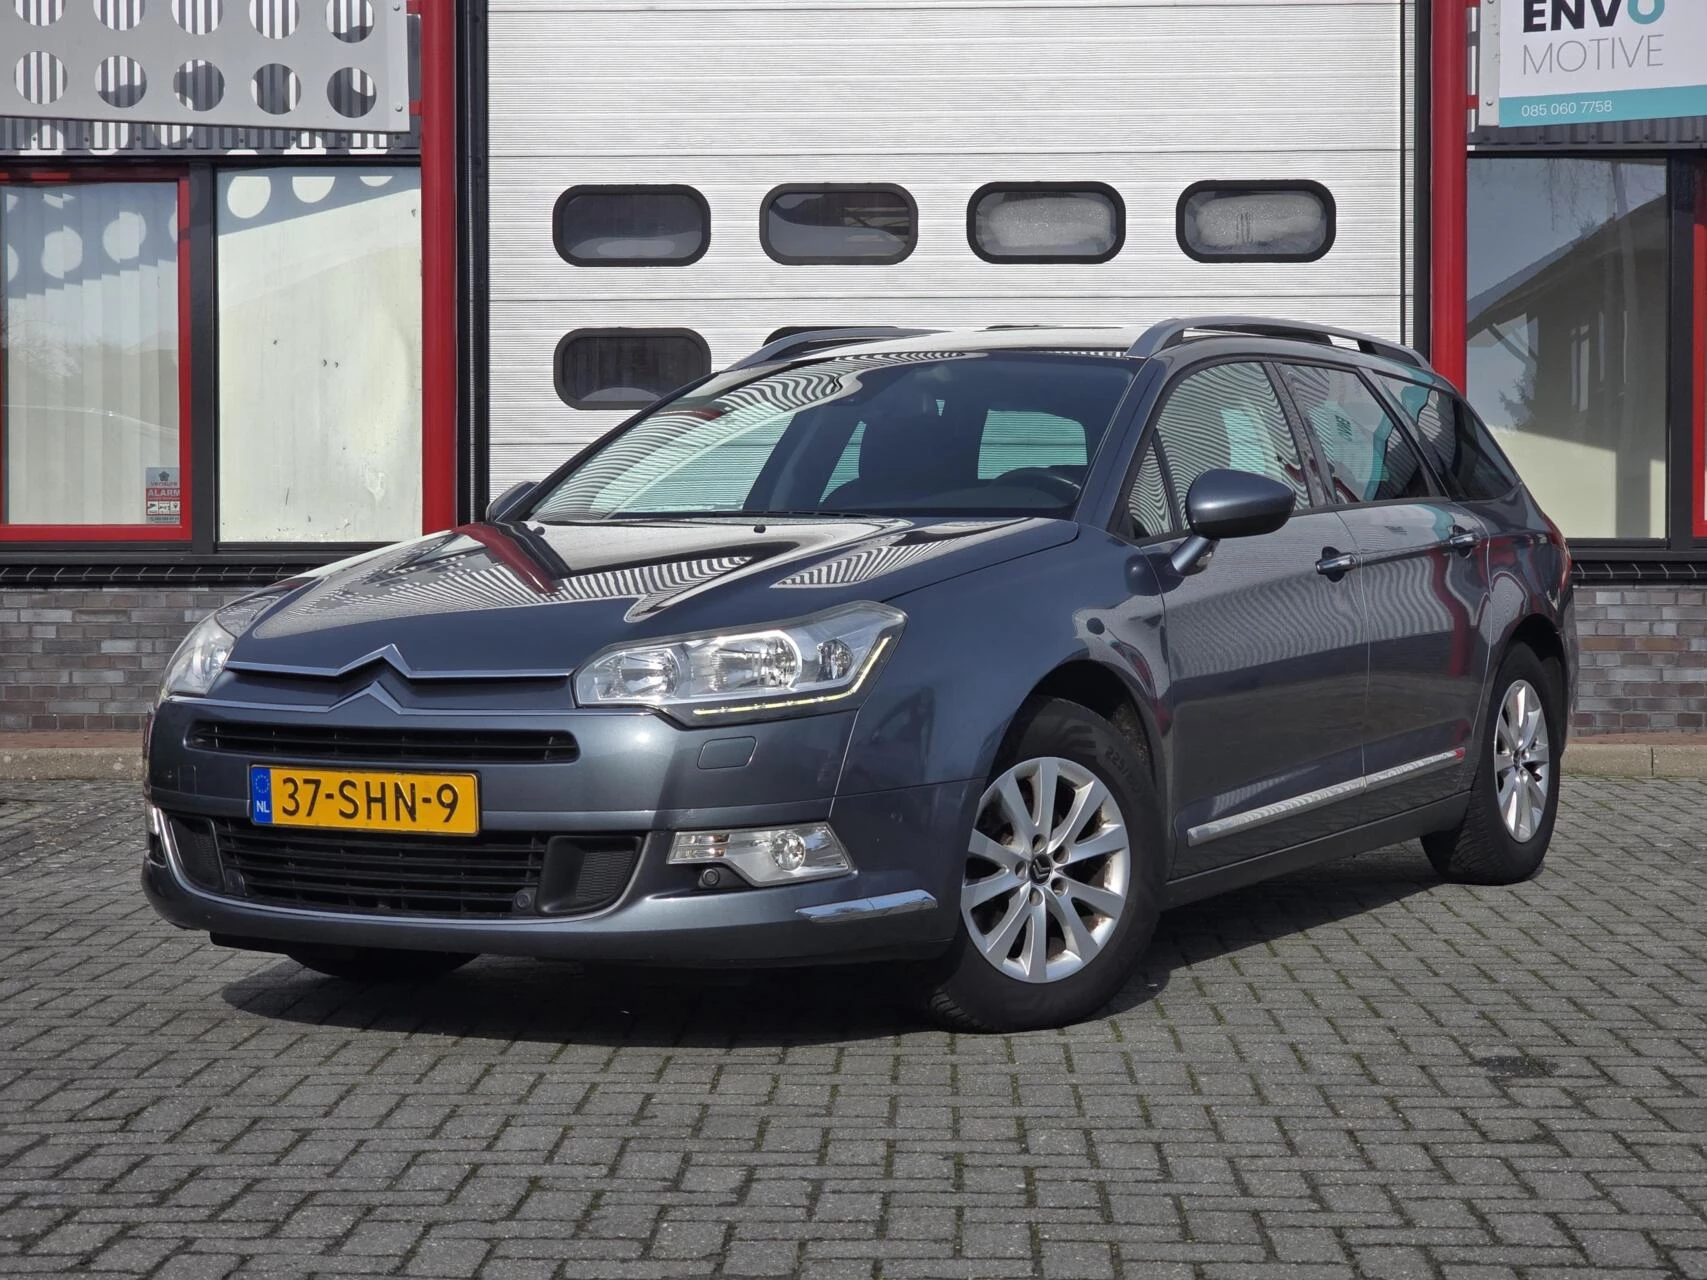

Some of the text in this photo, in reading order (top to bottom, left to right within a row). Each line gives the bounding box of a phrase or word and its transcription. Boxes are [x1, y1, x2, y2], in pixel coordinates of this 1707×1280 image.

[1523, 0, 1665, 32] ENVO
[1523, 34, 1664, 75] MOTIVE
[1521, 100, 1613, 117] 085 060 7758
[148, 489, 180, 497] ALARM
[256, 776, 459, 823] NL 37-SHN-9
